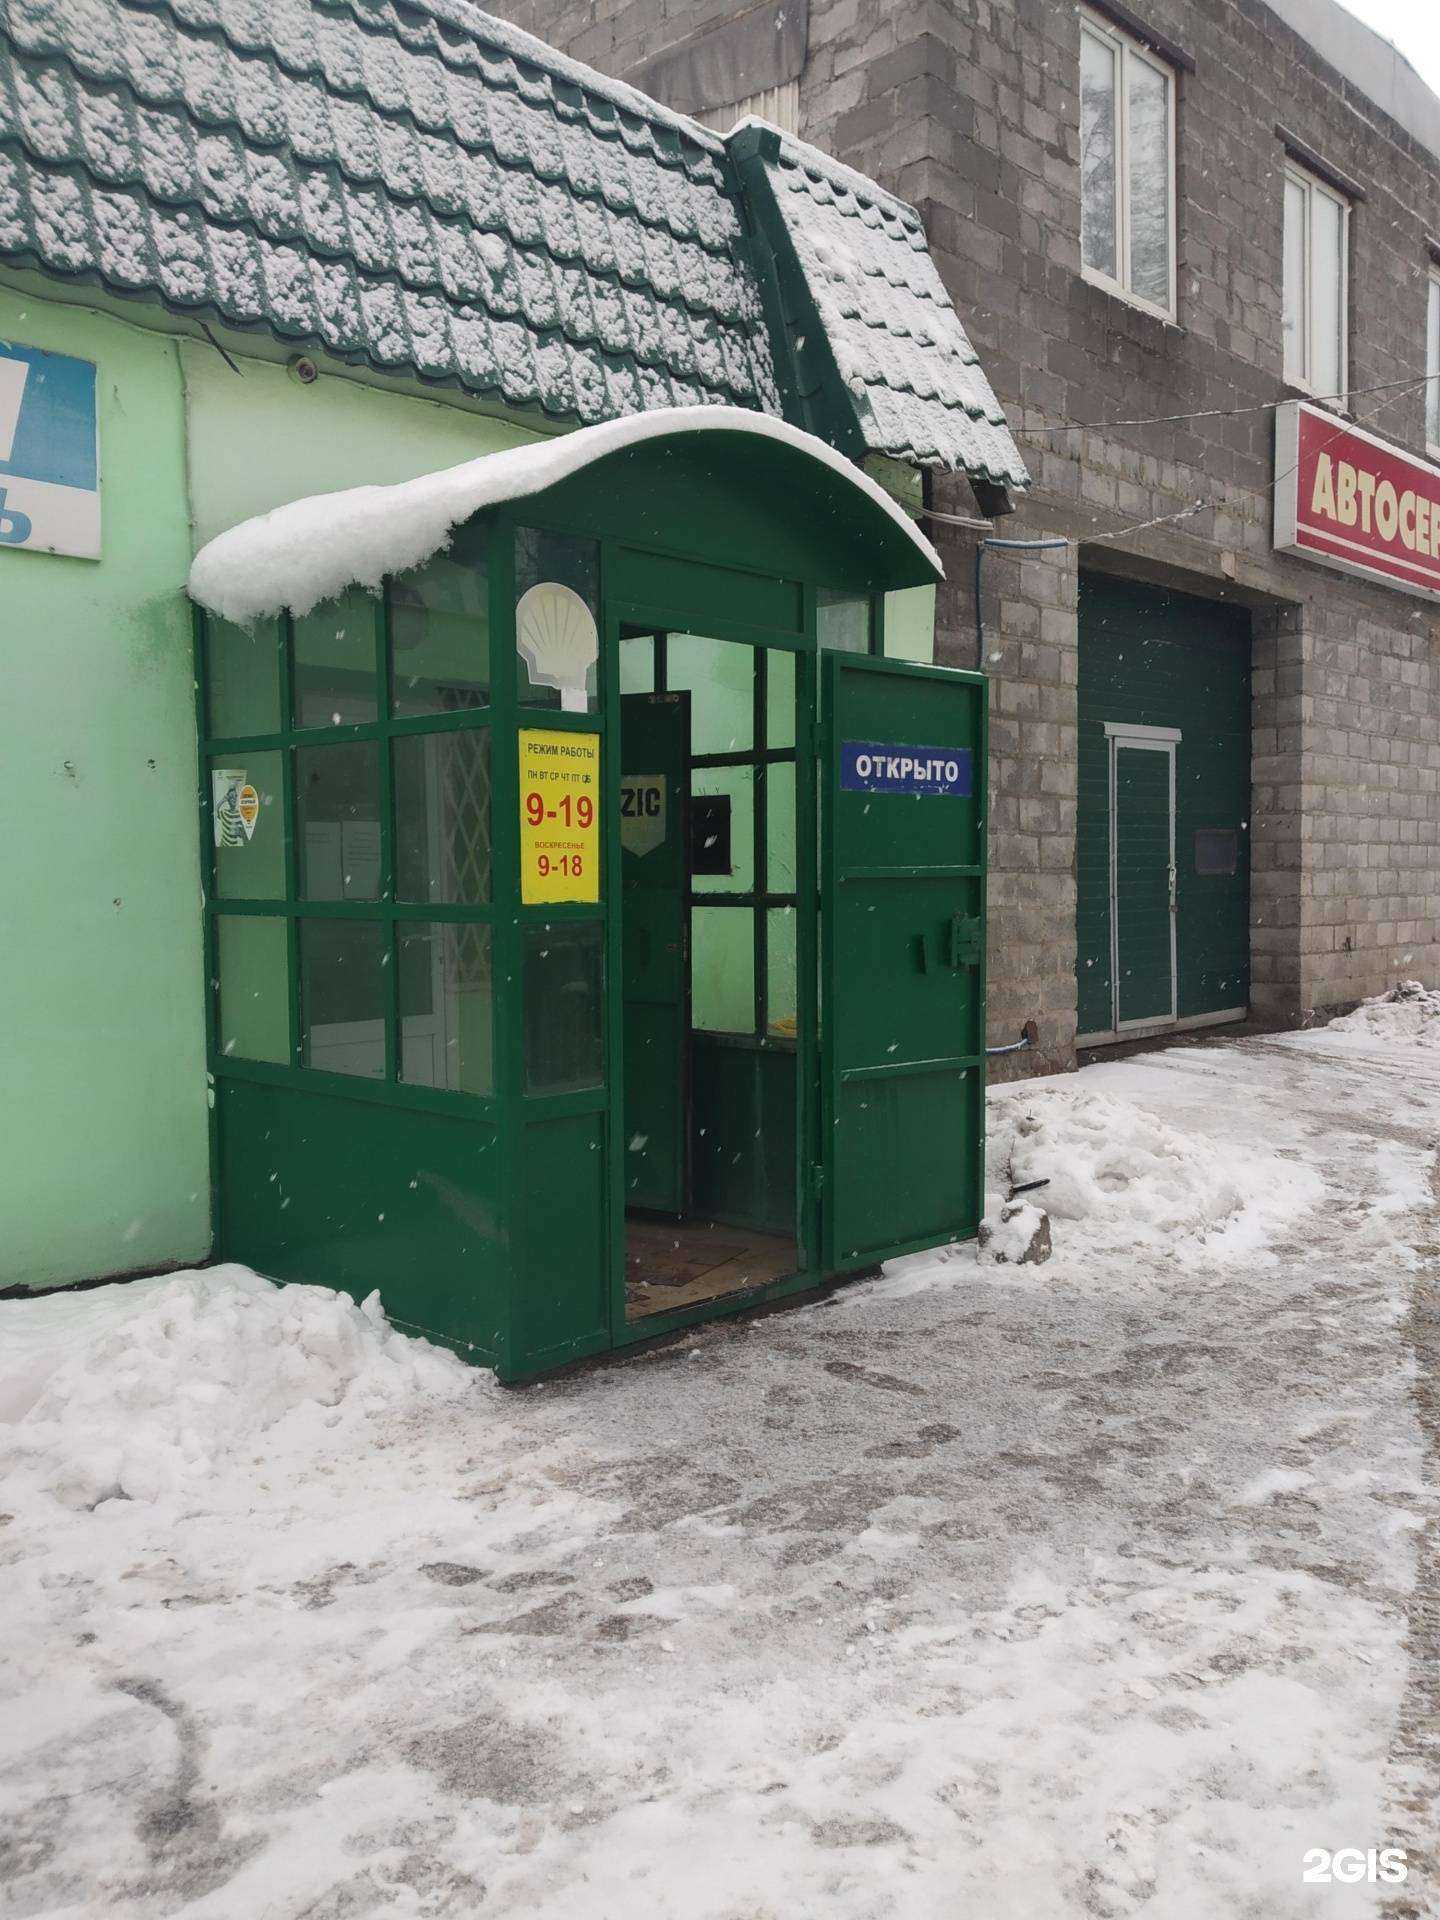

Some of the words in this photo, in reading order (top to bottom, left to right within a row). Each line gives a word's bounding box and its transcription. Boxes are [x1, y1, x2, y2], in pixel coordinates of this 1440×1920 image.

[528, 743, 558, 756] РЕЖИМ
[560, 746, 594, 758] РАБОТЫ
[528, 770, 537, 779] ПН
[540, 771, 548, 780] ВТ
[550, 772, 559, 781] СР
[561, 773, 570, 781] ЧТ
[572, 774, 580, 782] ПТ
[856, 755, 959, 782] ОТКРЫТО
[527, 792, 593, 828] 9-19
[621, 788, 660, 817] ZIC
[535, 841, 585, 849] ВОСКРЕСЕНЬЕ
[538, 855, 582, 876] 9-18
